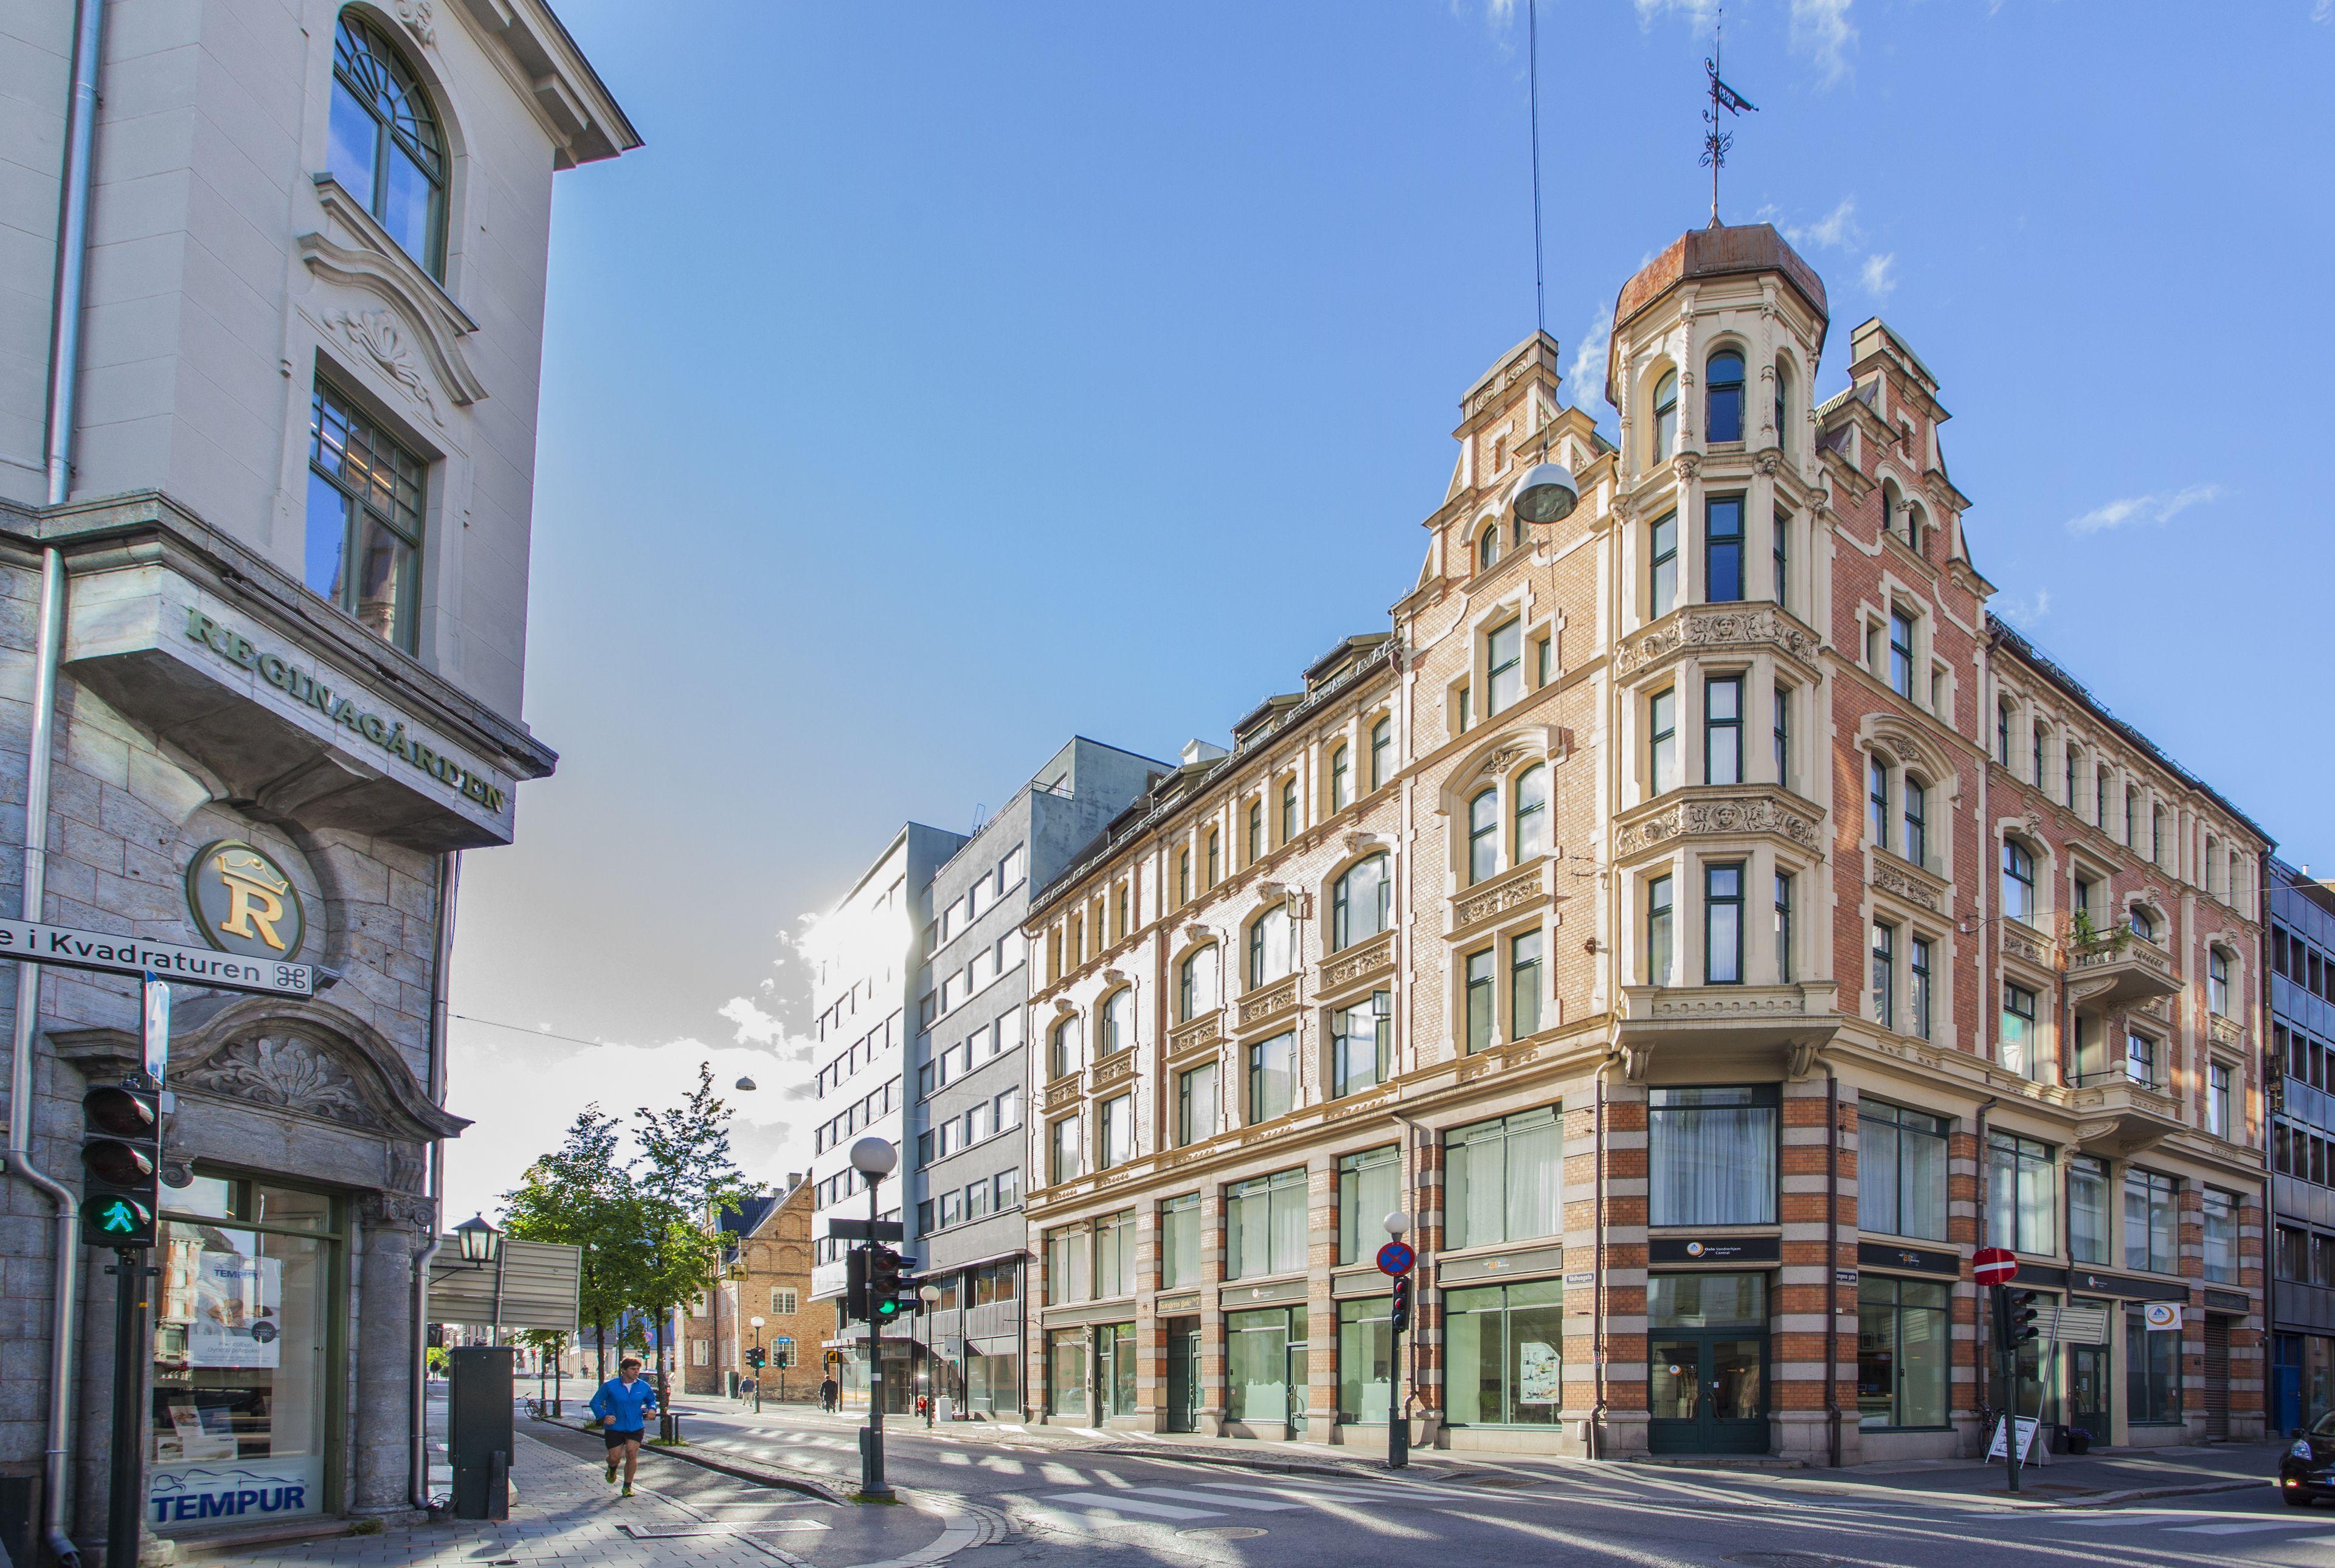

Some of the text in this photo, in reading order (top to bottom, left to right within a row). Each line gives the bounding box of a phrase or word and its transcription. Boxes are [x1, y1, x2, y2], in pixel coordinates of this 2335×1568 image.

[186, 609, 505, 814] REGINAGÅRDEN
[220, 876, 286, 950] R
[30, 928, 36, 949] i
[51, 932, 260, 982] Kvadraturen
[214, 1269, 258, 1280] TEMPUR
[1158, 1301, 1180, 1311] Kongens
[1181, 1300, 1192, 1309] gate
[151, 1486, 305, 1522] TEMPUR
